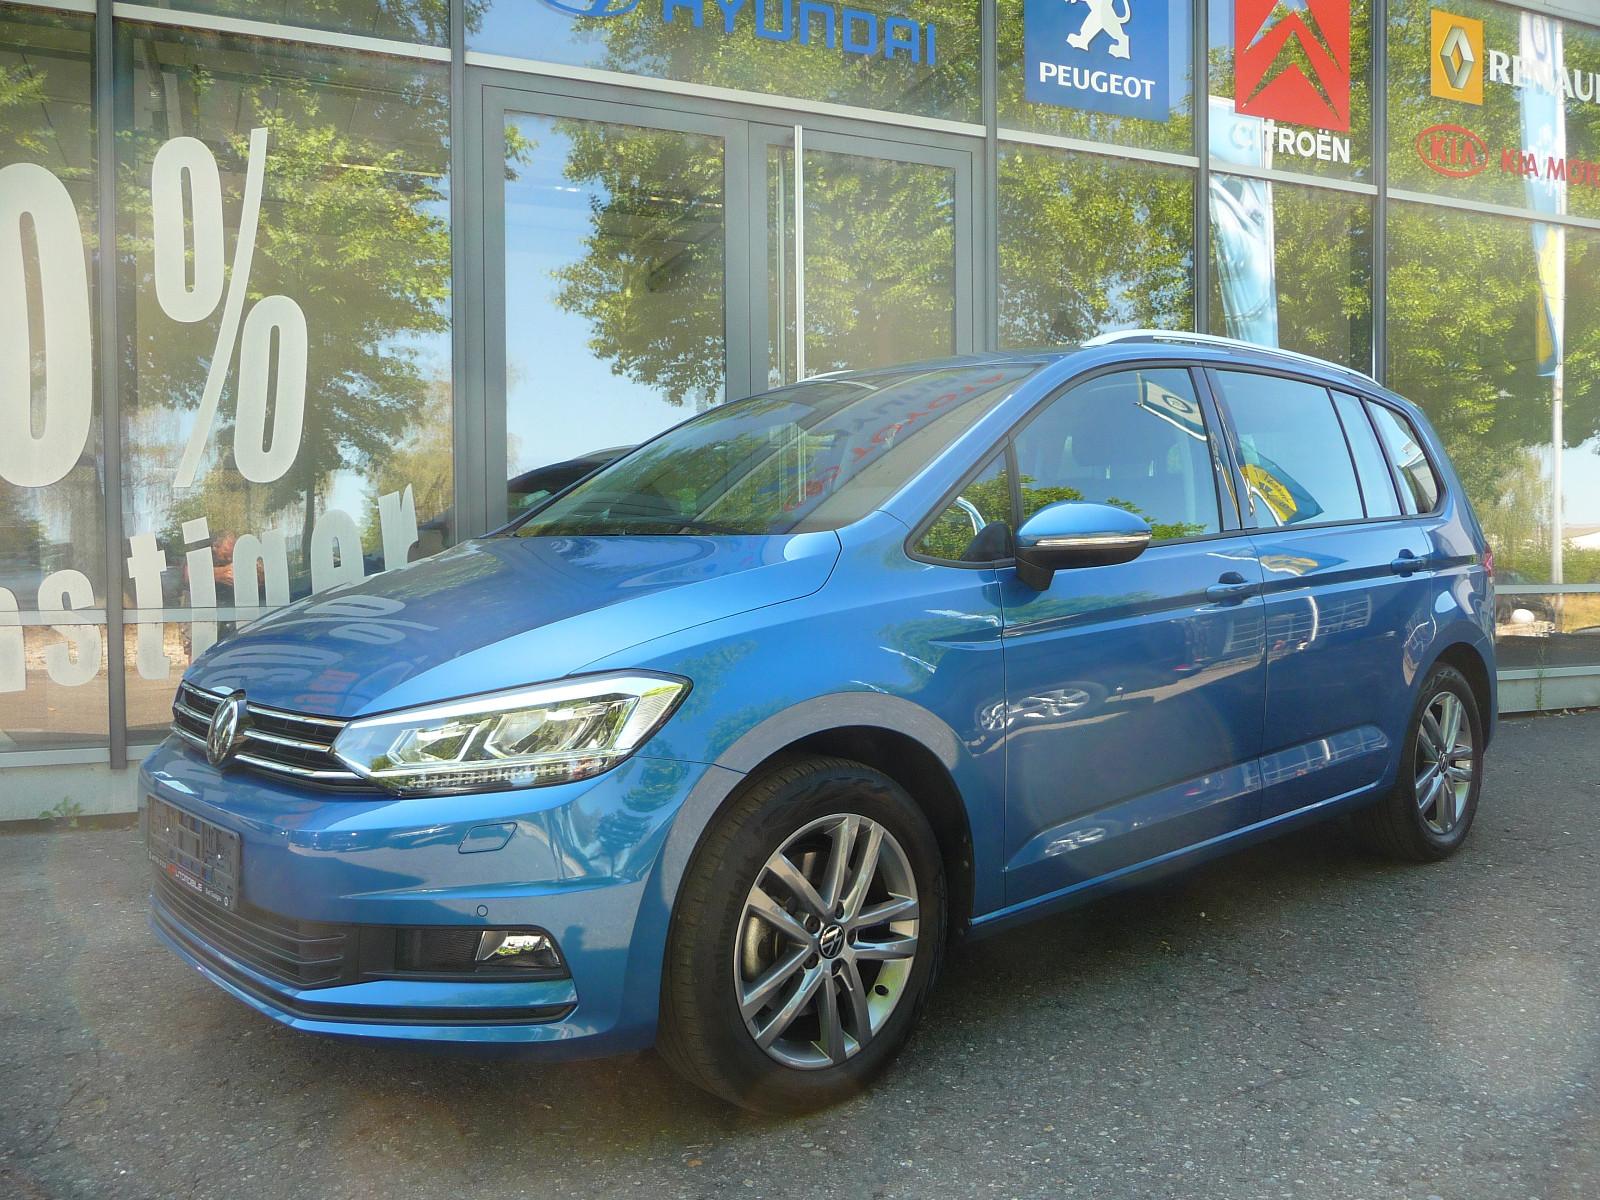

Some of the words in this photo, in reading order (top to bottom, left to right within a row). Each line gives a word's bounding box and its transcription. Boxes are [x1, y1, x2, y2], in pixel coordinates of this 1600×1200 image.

[663, 0, 936, 65] HYUNDAI
[1039, 62, 1156, 100] PEUGEOT
[1430, 135, 1478, 166] KIA
[1501, 146, 1539, 177] KIA
[151, 127, 308, 488] %
